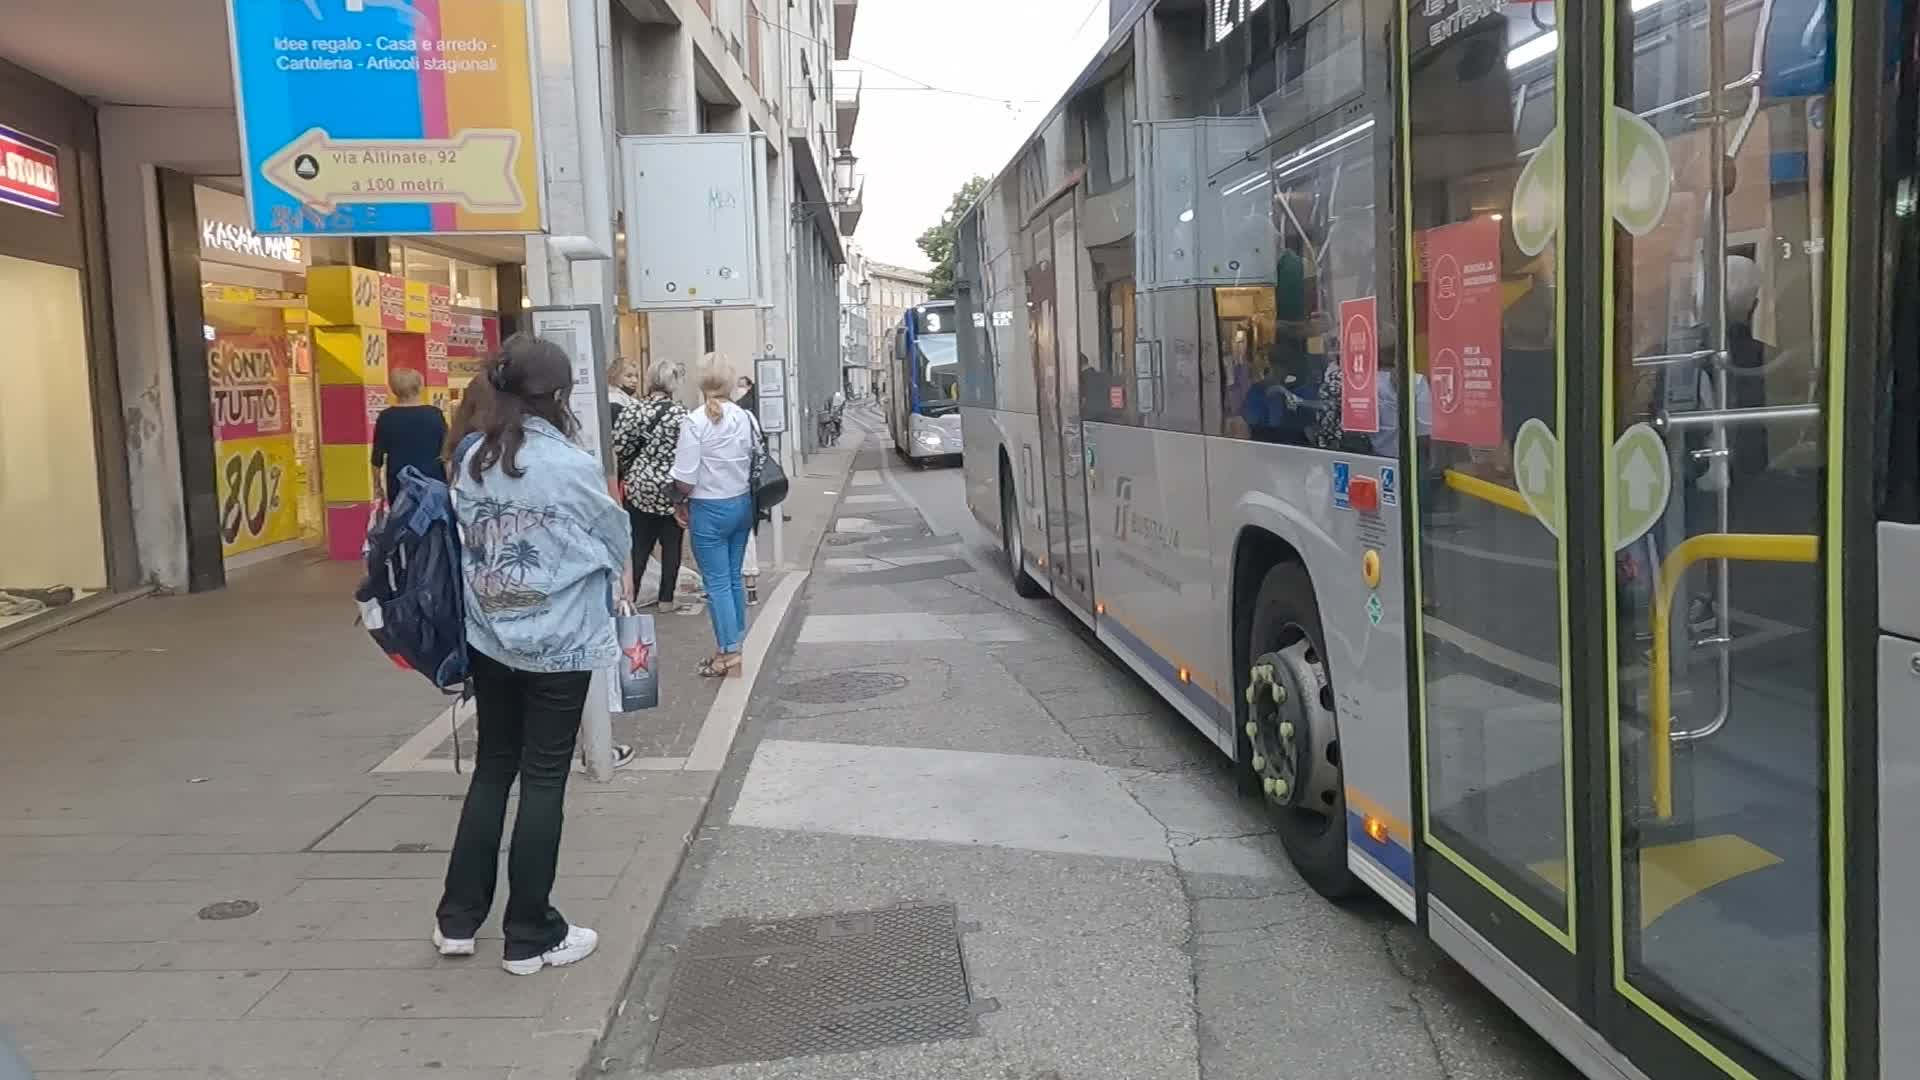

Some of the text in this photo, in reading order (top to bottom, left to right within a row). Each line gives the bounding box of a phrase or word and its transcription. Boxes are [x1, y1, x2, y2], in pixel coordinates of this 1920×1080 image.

[273, 37, 308, 51] Idee
[311, 37, 362, 55] regalo
[375, 37, 417, 51] Casa
[422, 40, 432, 51] e
[436, 37, 487, 51] arredo
[276, 56, 353, 71] Cartoleria
[366, 56, 420, 71] Articoli
[423, 57, 498, 74] stagionali
[332, 150, 457, 167] via Altinate, 92
[351, 177, 445, 192] a 100 metri
[926, 313, 941, 332] 3
[209, 343, 276, 382] SKONTA
[213, 387, 279, 422] TUTTO
[223, 449, 282, 544] 80%
